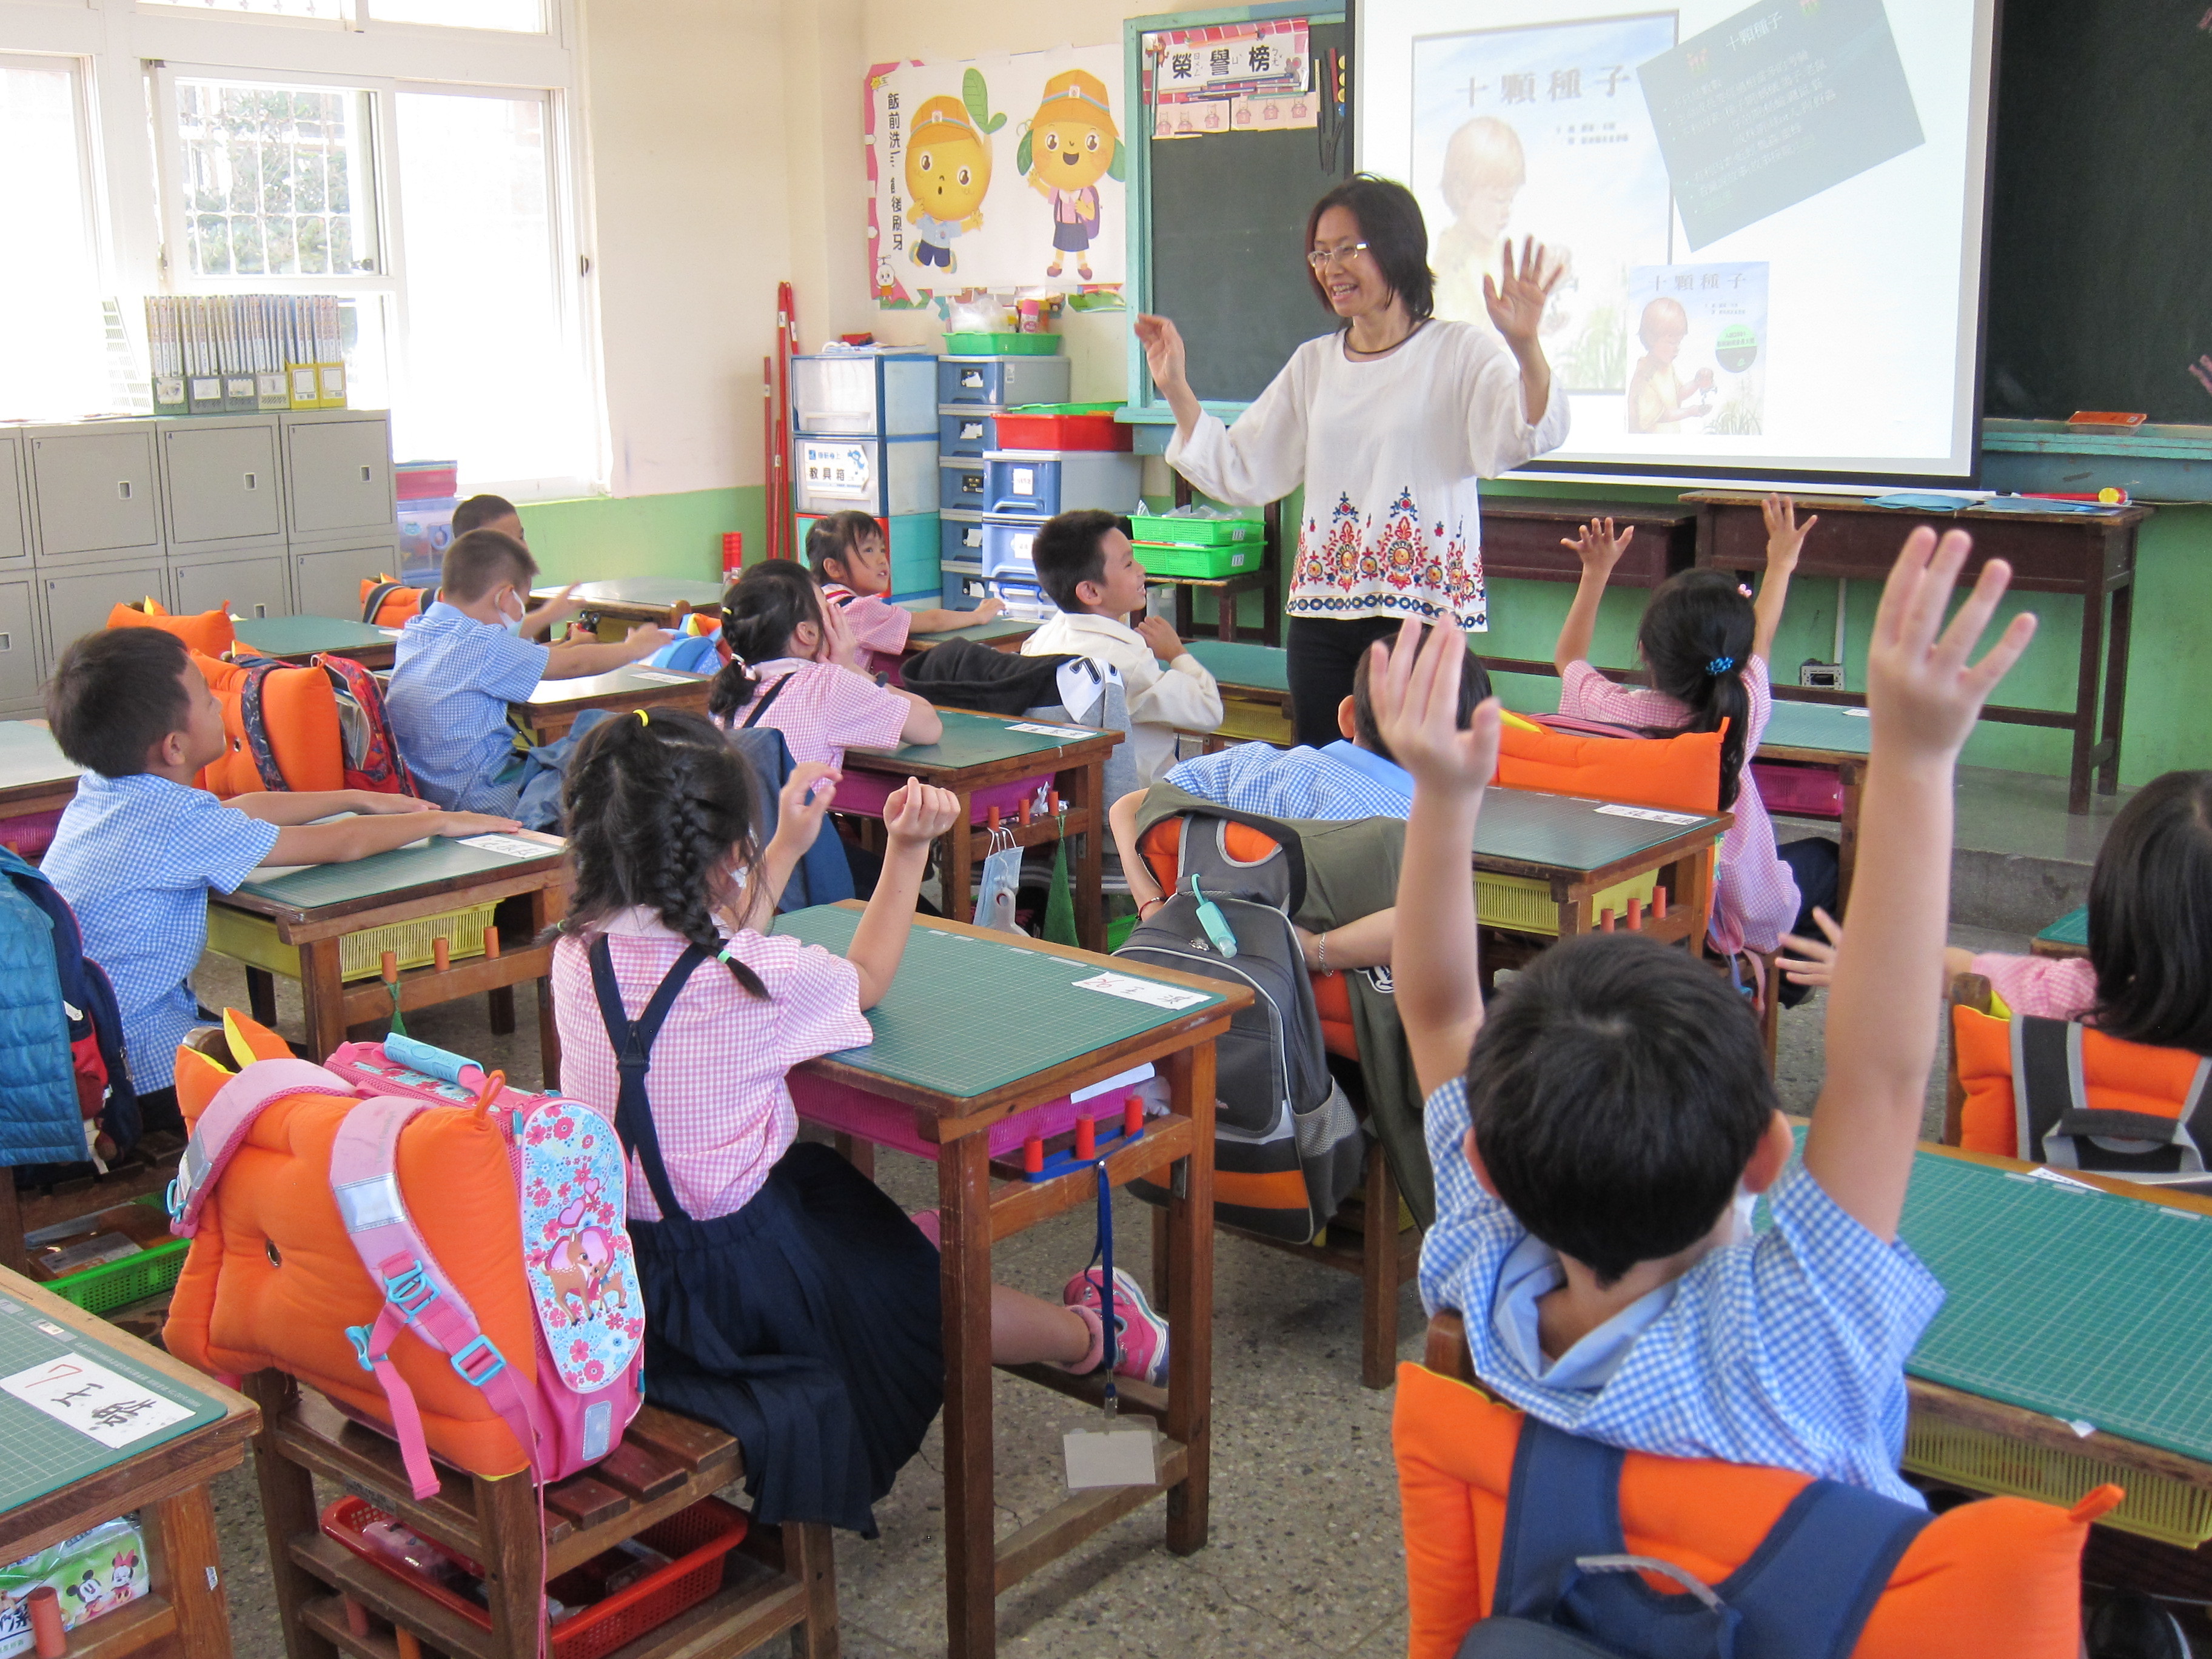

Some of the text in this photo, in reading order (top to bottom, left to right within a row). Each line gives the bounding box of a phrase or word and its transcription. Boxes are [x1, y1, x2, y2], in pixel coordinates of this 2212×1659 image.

[1171, 45, 1270, 79] 榮譽榜
[1454, 64, 1632, 109] 十顆種子
[1648, 273, 1746, 291] 十顆種子
[809, 467, 845, 481] 教具箱
[25, 1364, 83, 1388] 7
